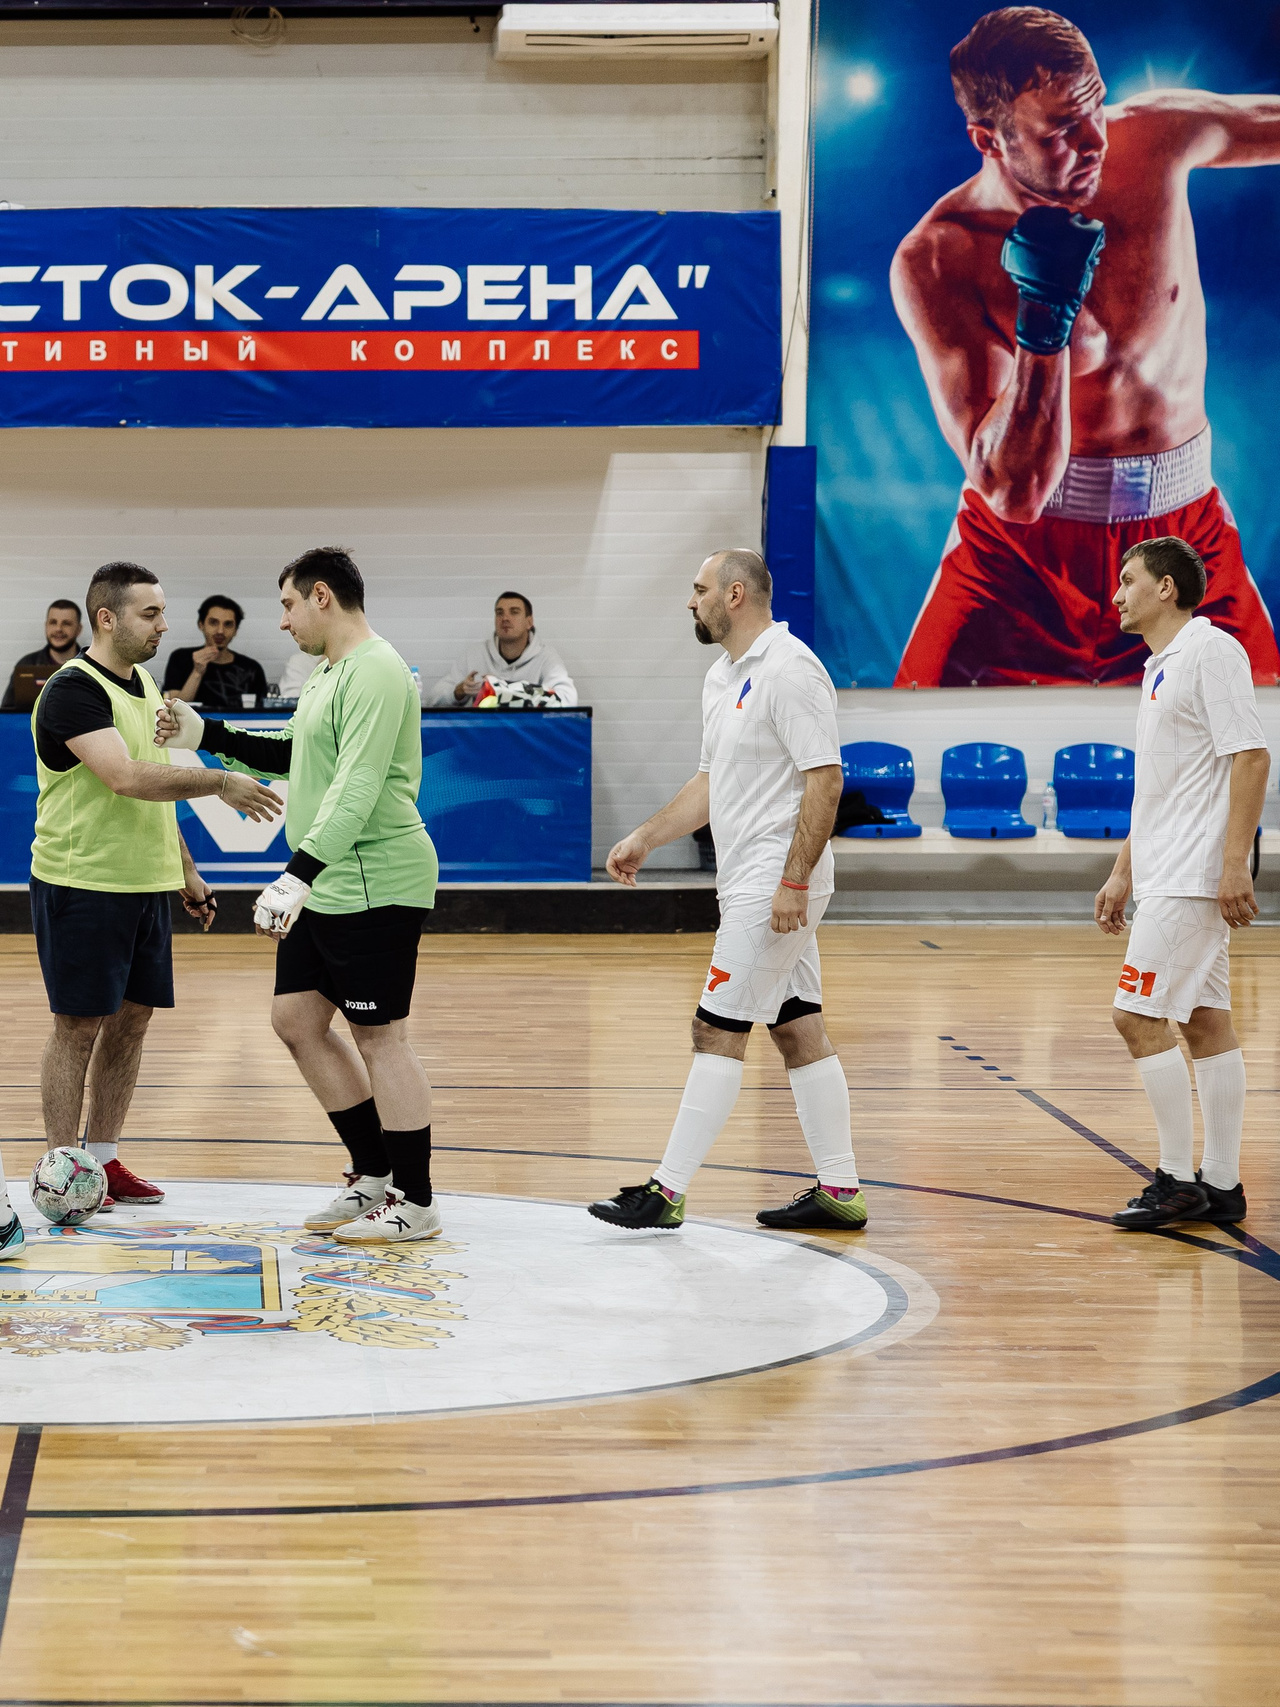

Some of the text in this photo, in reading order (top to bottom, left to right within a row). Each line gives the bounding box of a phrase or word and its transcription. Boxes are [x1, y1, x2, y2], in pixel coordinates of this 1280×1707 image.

[351, 337, 679, 362] КОМПЛЕКС
[708, 964, 731, 993] 7
[1118, 963, 1157, 998] 21
